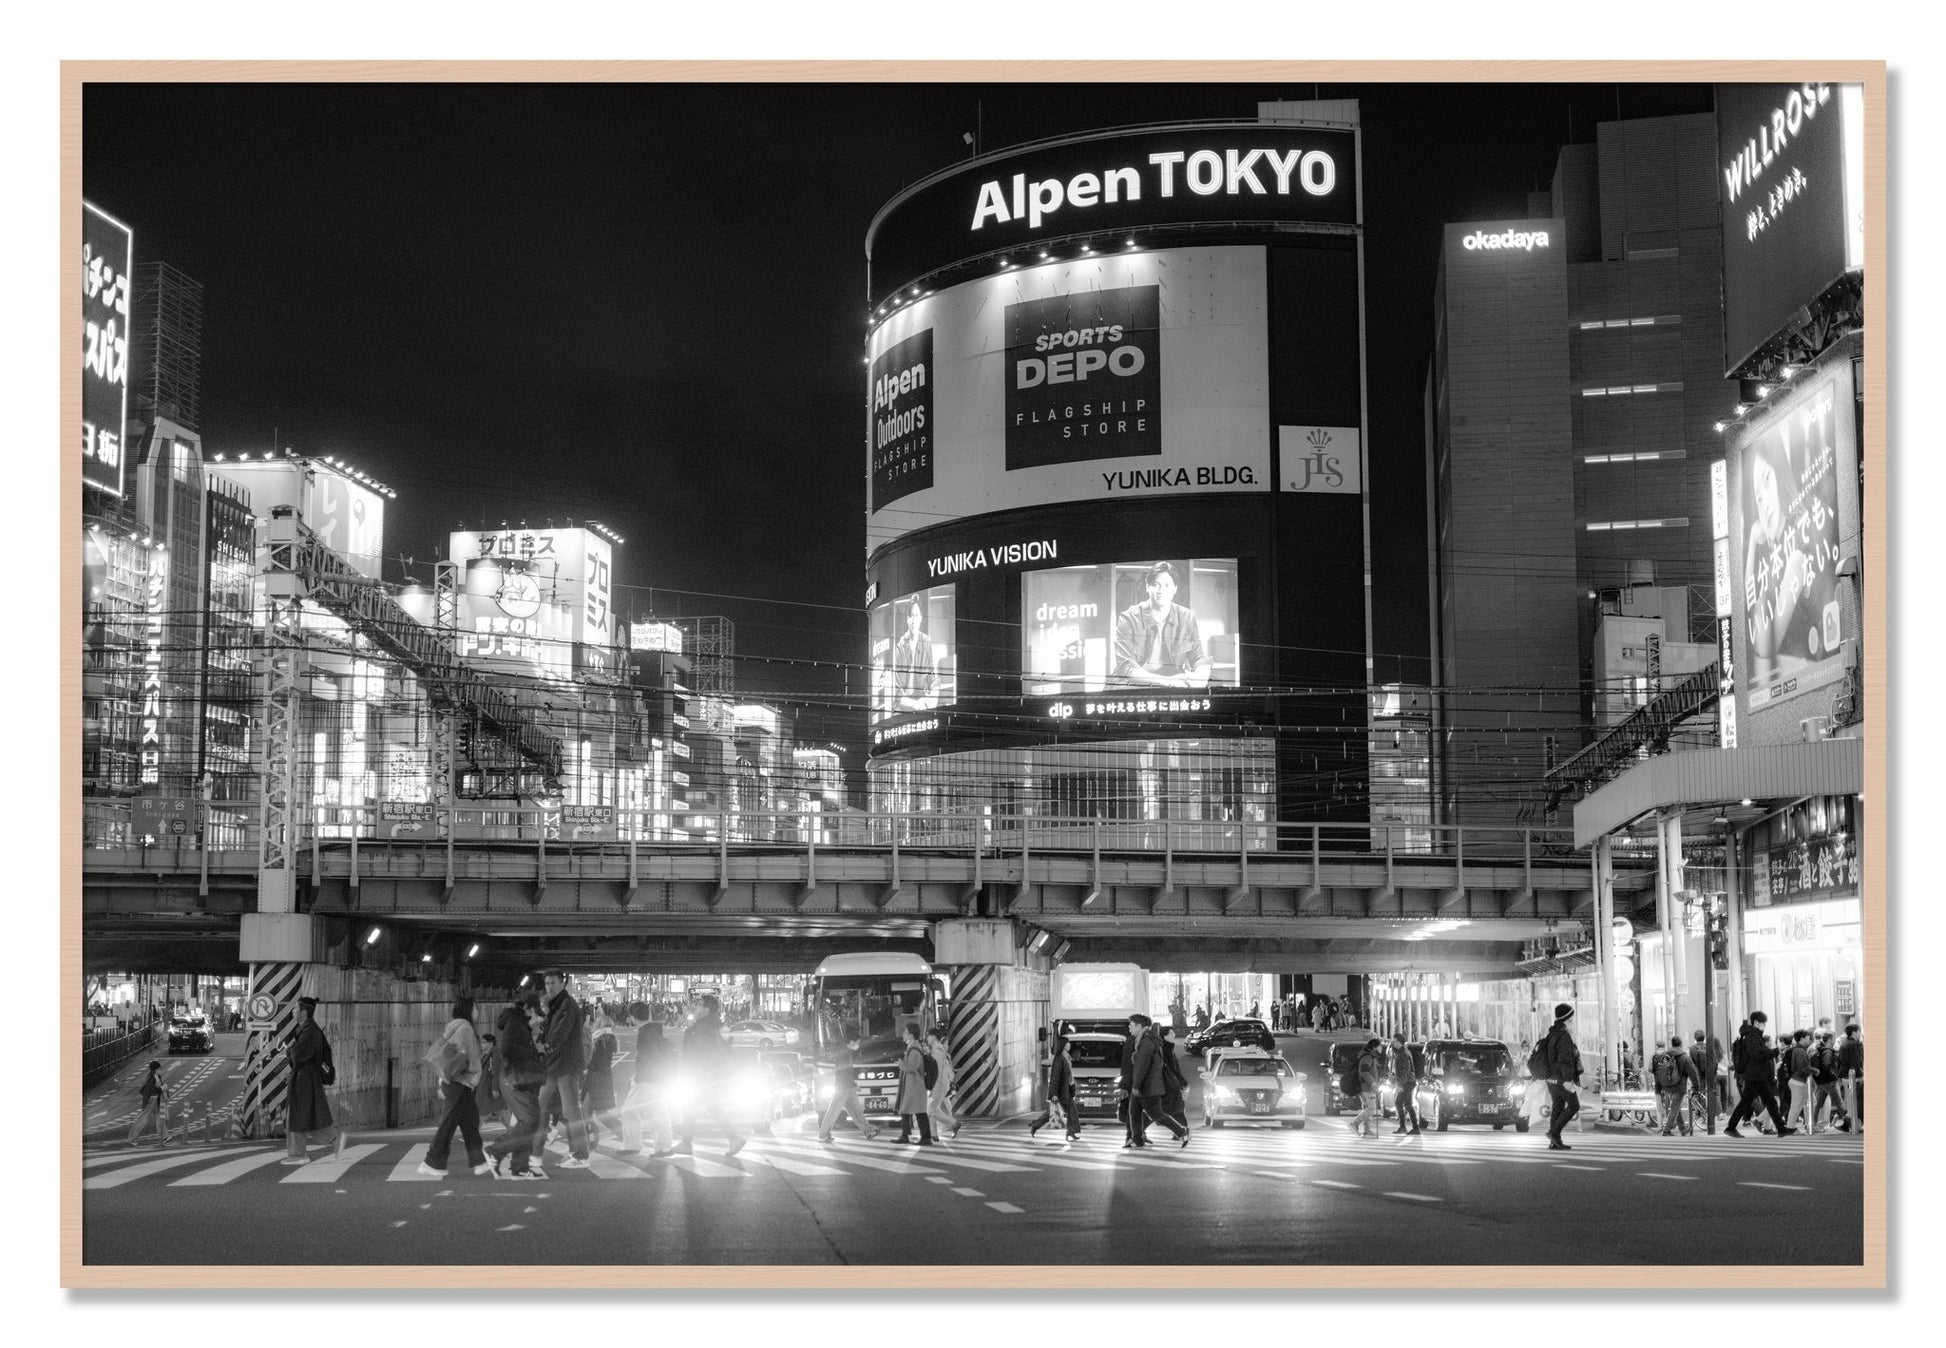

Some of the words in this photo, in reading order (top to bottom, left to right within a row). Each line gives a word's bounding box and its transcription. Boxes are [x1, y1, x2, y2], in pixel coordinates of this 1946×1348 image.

[971, 165, 1141, 230] Alpen
[1148, 148, 1336, 197] TOKYO
[1463, 228, 1549, 251] okadaya
[1035, 325, 1123, 352] SPORTS
[1016, 345, 1145, 390] DEPO
[874, 363, 925, 413] Alpen
[1016, 399, 1146, 426] FLAGSHIP
[878, 405, 924, 449] Outdoors
[1063, 418, 1146, 439] STORE
[874, 436, 926, 472] FLAGSHIP
[889, 455, 926, 480] STORE
[1102, 468, 1190, 491] YUNIKA
[1197, 466, 1258, 487] BLDG.
[217, 540, 249, 563] SHISHA
[928, 549, 988, 577] YUNIKA
[991, 539, 1058, 565] VISION
[1745, 497, 1834, 611] 自分本位でも、
[1749, 539, 1839, 644] いいじゃない。
[1036, 603, 1098, 621] dream
[1049, 702, 1073, 719] dip
[1085, 699, 1211, 715] 夢を叶える仕事に出会おう
